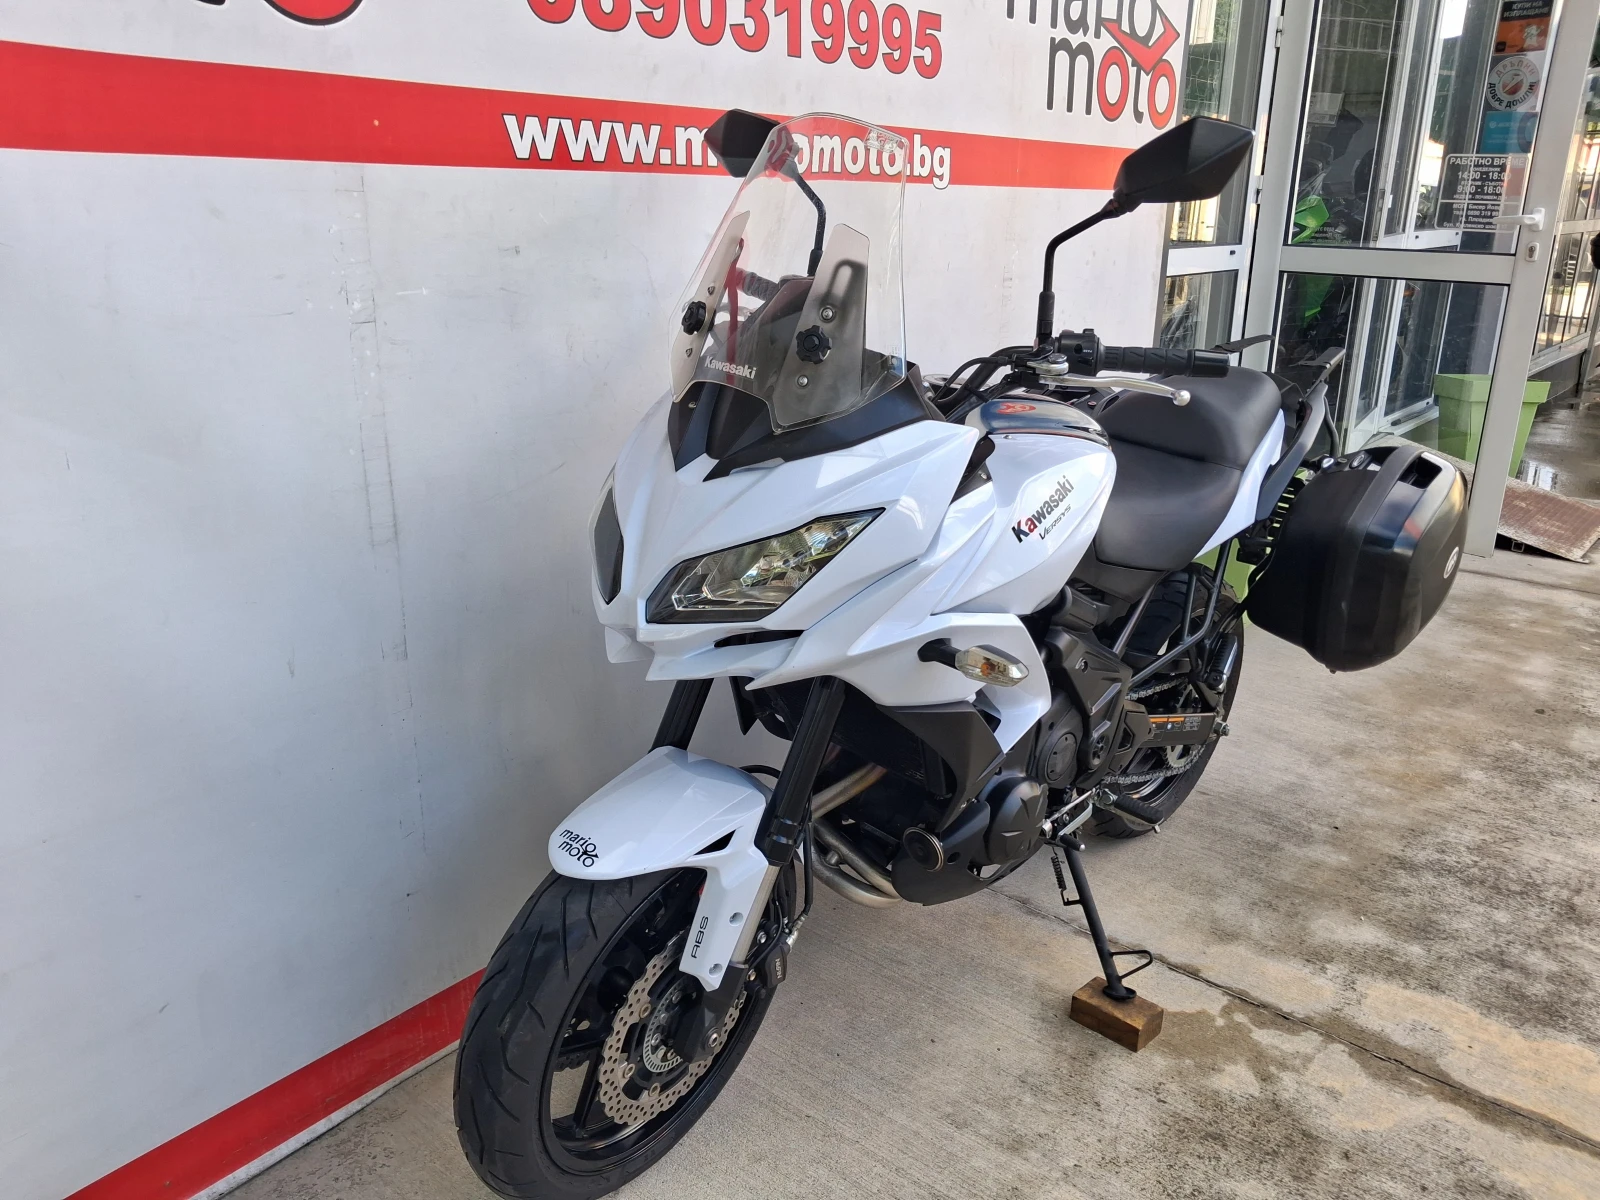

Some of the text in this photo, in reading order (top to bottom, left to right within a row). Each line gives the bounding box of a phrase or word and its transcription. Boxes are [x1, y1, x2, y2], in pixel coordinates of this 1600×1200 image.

[1495, 60, 1535, 78] ДРЪПНИ
[1046, 36, 1177, 130] moto
[1488, 82, 1504, 107] ДОБРЕ
[502, 113, 951, 190] www.momoto.bg
[1450, 157, 1492, 166] РАБОТНО
[1458, 171, 1480, 180] 14:00
[1457, 185, 1476, 193] 9:00
[704, 355, 757, 379] Kawasaki
[1011, 474, 1075, 544] Kawasaki
[557, 840, 596, 868] moto
[558, 829, 597, 854] mario
[690, 915, 709, 959] ABS
